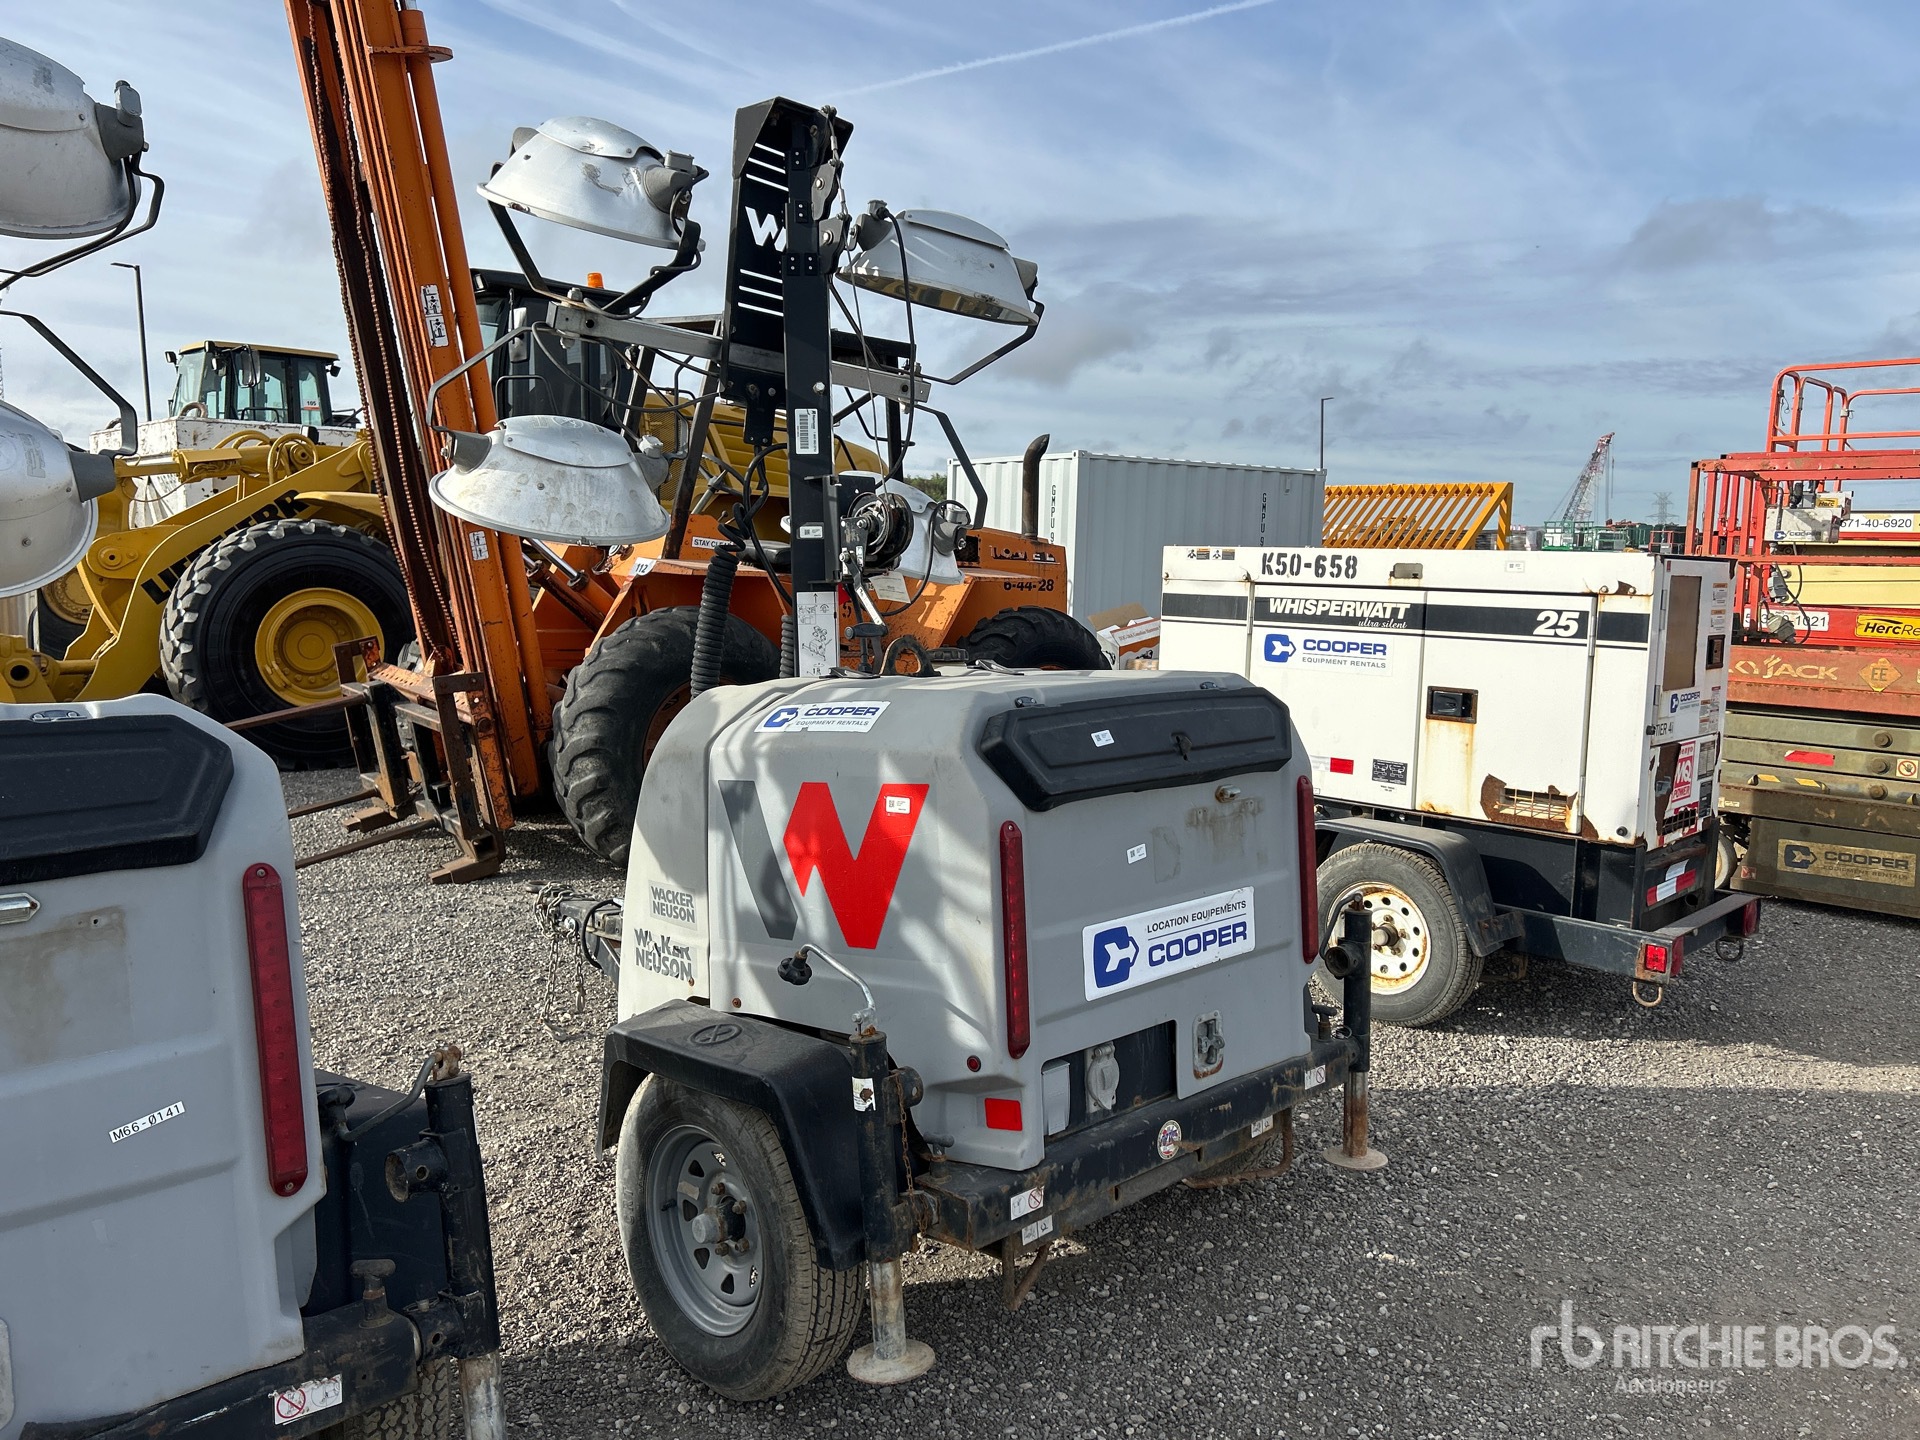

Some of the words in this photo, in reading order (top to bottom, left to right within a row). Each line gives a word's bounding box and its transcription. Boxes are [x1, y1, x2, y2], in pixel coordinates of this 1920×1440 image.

[141, 489, 310, 605] LIERR
[693, 538, 710, 547] STAY
[635, 563, 649, 574] 112
[1261, 551, 1359, 580] K50-658
[1269, 597, 1412, 620] WHISPERWATT
[1358, 618, 1380, 628] ultra
[1381, 618, 1408, 629] silent
[1533, 610, 1580, 638] 25
[1303, 638, 1387, 656] COOPER
[1302, 656, 1348, 667] EQUIPMENT
[1350, 660, 1387, 669] RENTALS
[1728, 654, 1839, 681] JACK
[1871, 667, 1889, 682] EE
[1680, 690, 1700, 702] COOPER
[804, 706, 881, 716] COOPER
[1824, 851, 1909, 870] COOPER
[650, 885, 695, 909] WACKER
[652, 900, 696, 924] NEUSON
[1147, 914, 1189, 934] LOCATION
[1191, 900, 1247, 922] EQUIPEMENTS
[634, 928, 692, 961] WKER
[1148, 921, 1247, 967] COOPER
[635, 947, 693, 981] NEUSON
